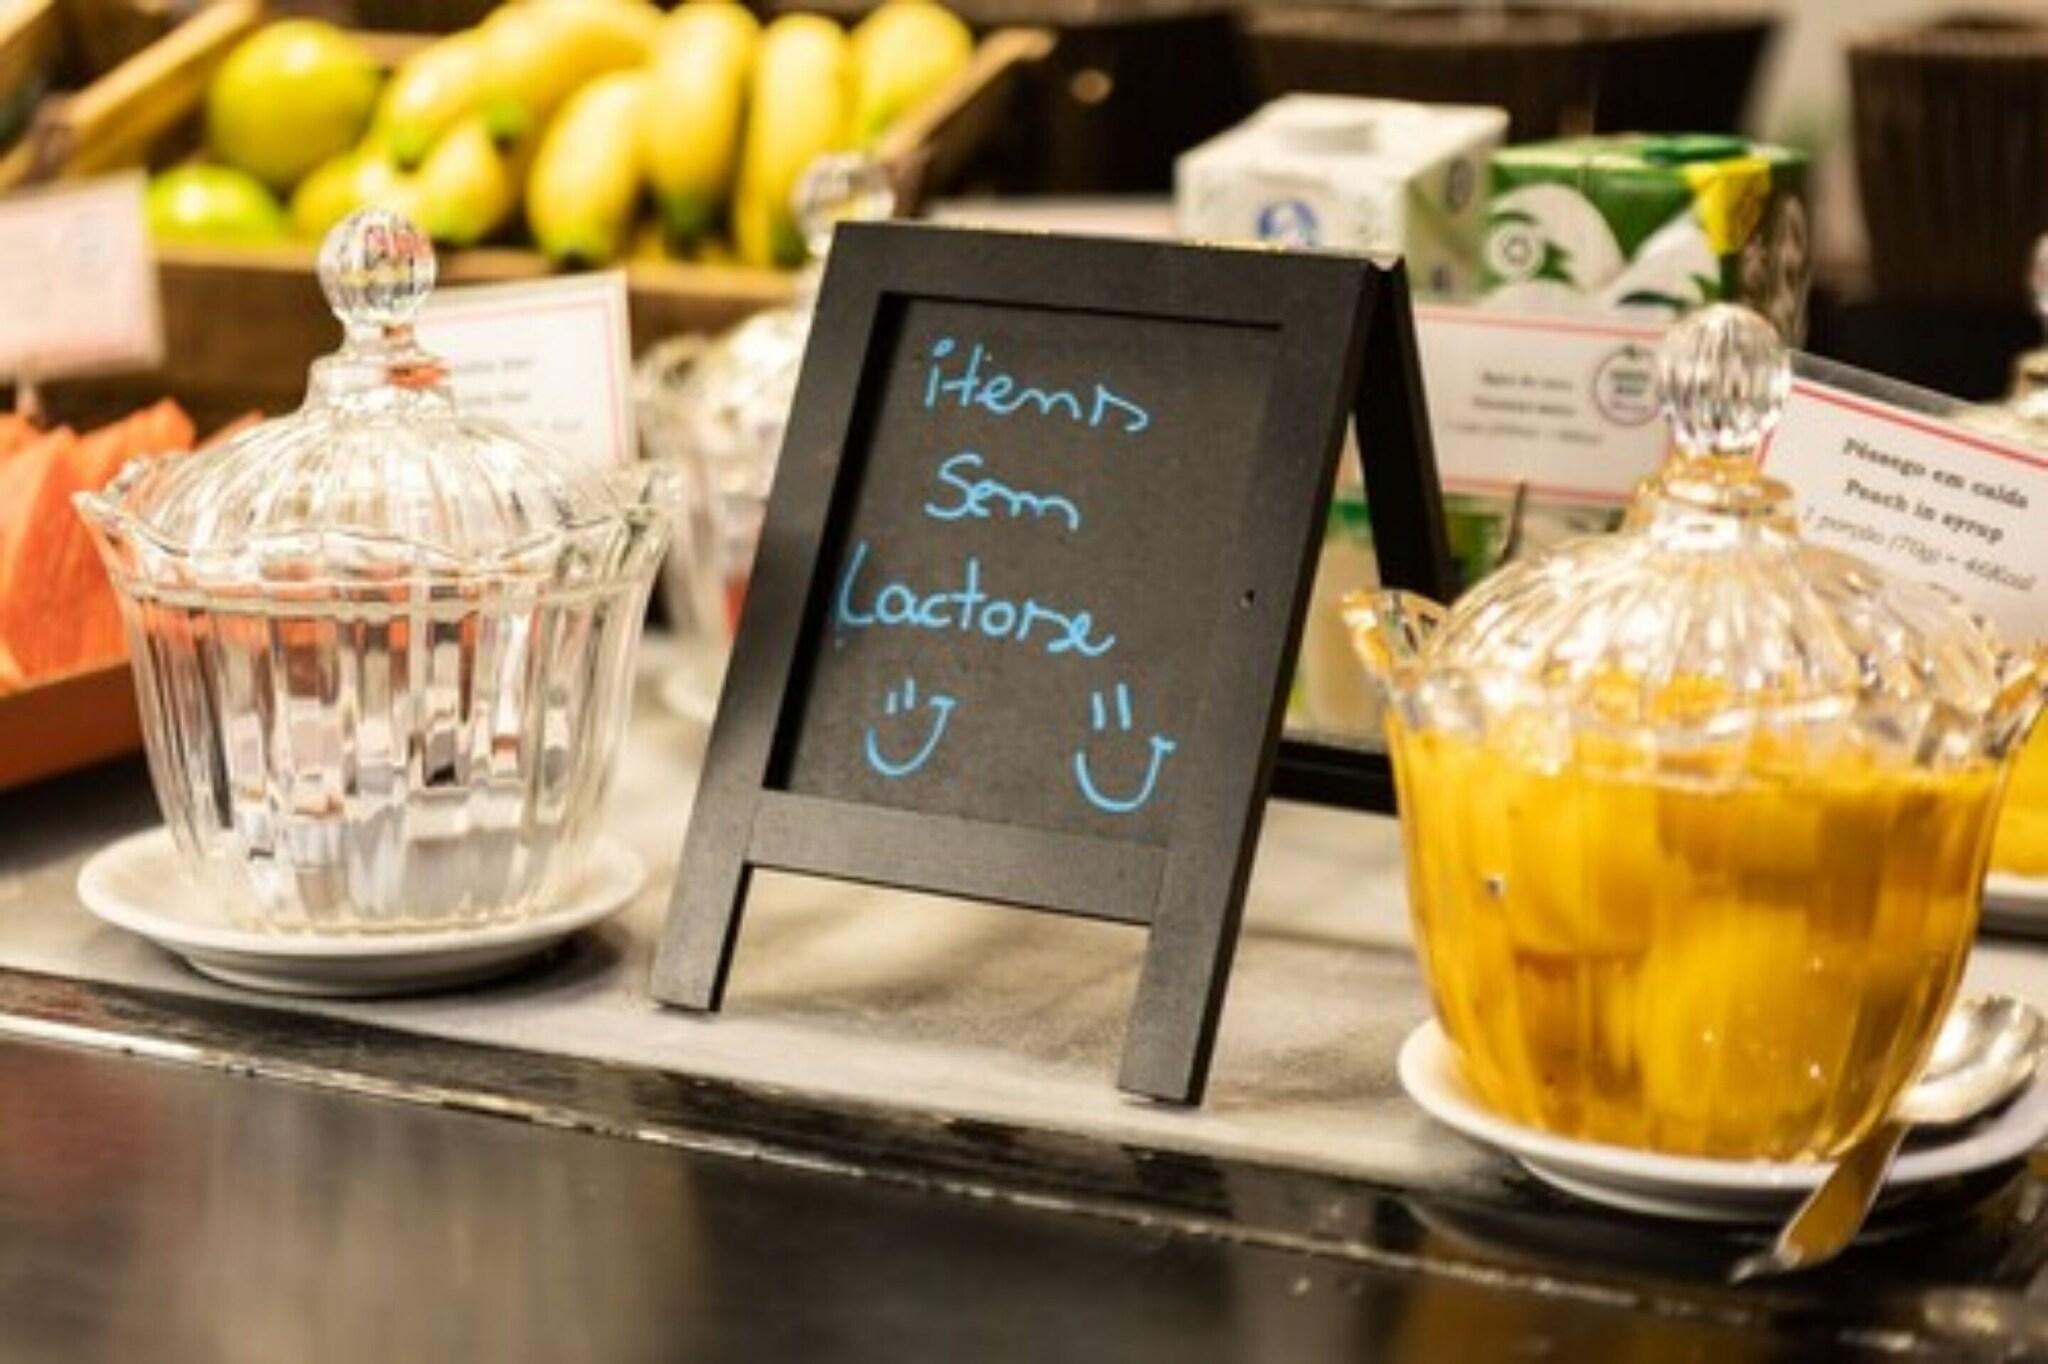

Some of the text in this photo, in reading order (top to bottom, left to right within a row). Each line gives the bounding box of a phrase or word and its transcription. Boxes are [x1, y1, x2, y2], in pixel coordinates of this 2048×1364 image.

[1844, 478, 2004, 544] Peach in syrup
[838, 541, 1116, 655] Lactose
